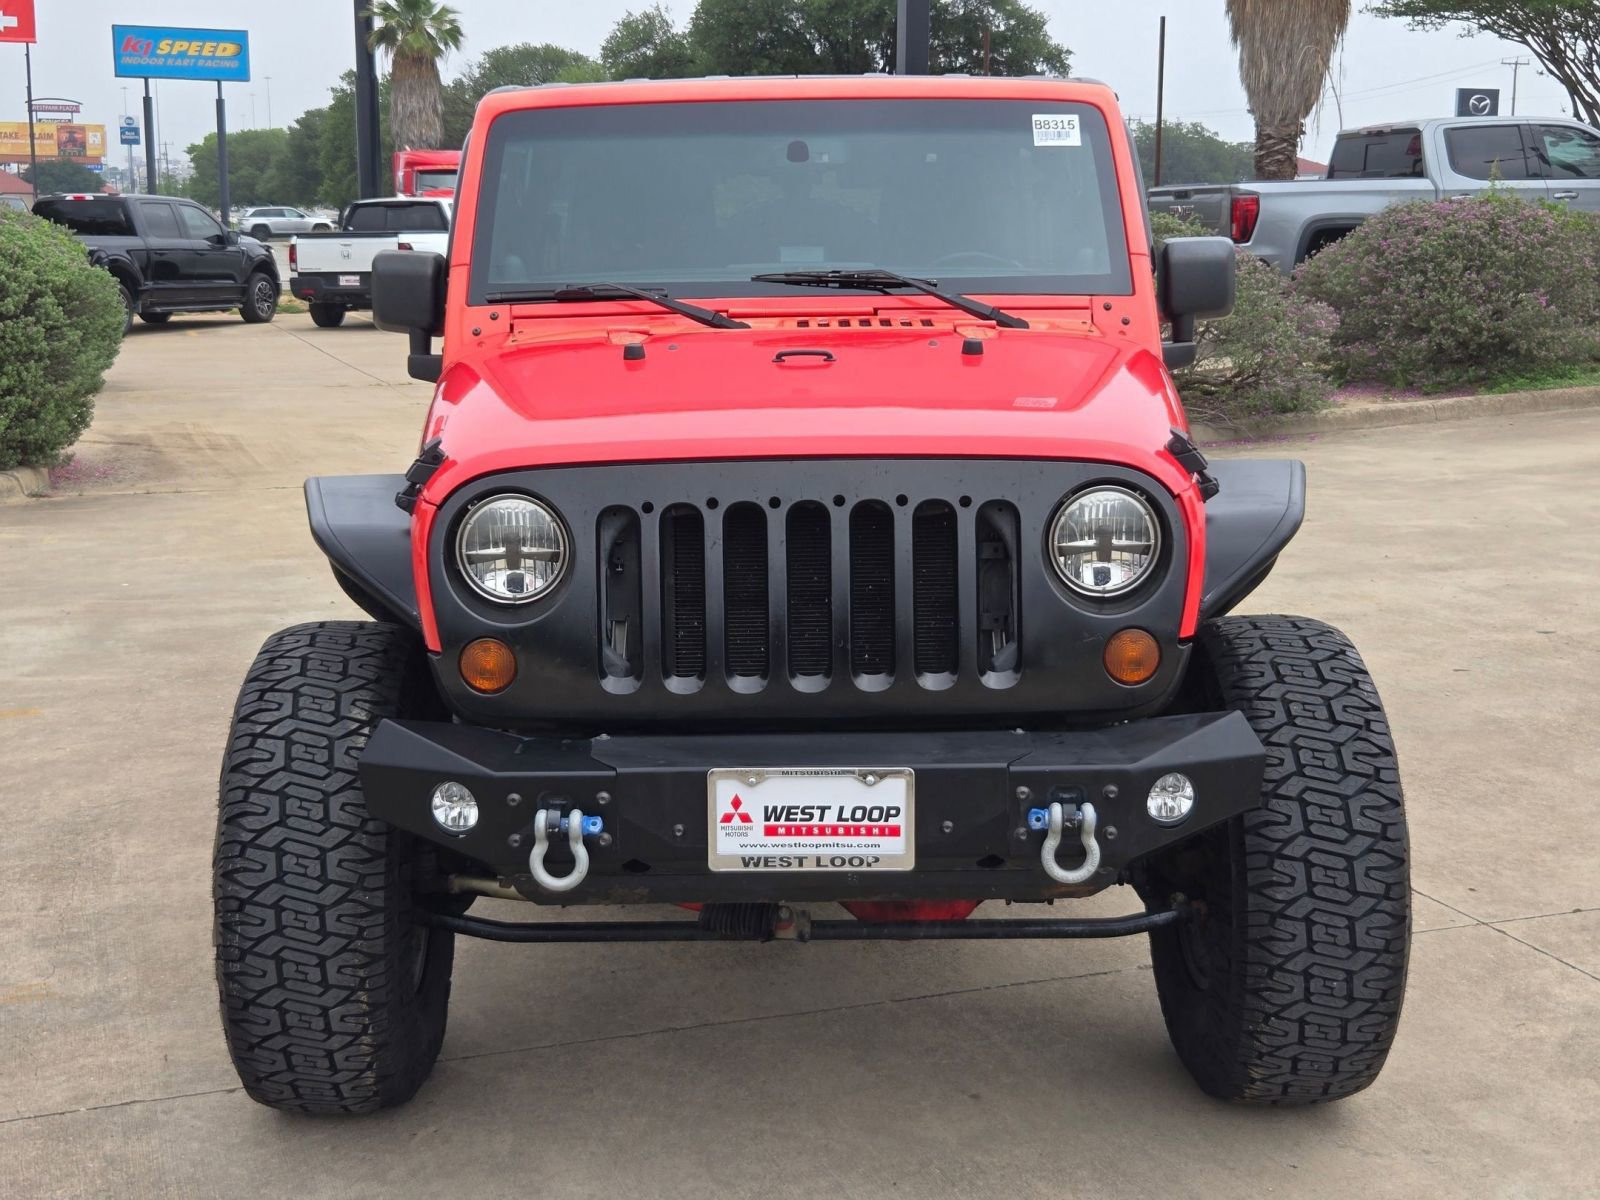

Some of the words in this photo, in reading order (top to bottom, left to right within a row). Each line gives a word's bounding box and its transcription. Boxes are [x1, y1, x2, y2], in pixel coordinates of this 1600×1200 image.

[122, 36, 152, 57] K1
[156, 39, 242, 57] SPEED
[122, 57, 164, 65] INDOOR
[167, 58, 194, 66] KART
[198, 59, 239, 68] RACING
[1034, 119, 1076, 130] B8315
[763, 805, 831, 823] WEST
[836, 805, 901, 823] LOOP
[778, 827, 889, 835] MITSUBISHI
[741, 856, 808, 868] WEST
[816, 856, 880, 868] LOOP
